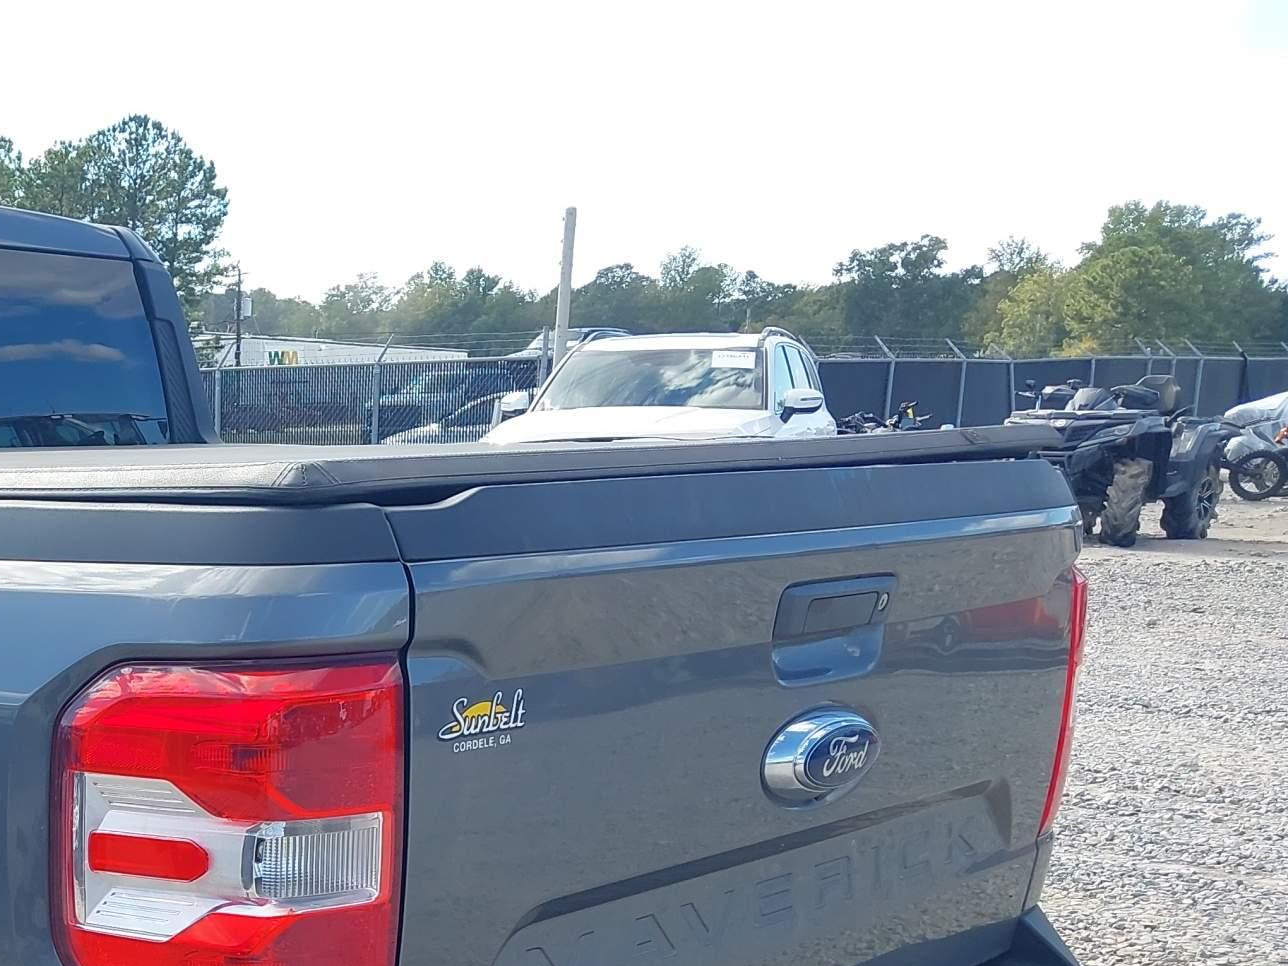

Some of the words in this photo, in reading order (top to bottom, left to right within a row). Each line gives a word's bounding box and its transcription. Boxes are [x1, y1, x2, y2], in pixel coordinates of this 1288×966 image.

[268, 350, 298, 365] WM
[438, 688, 526, 739] Sunbelt
[453, 736, 497, 753] CORDELE,
[499, 734, 512, 745] GA
[823, 734, 869, 778] Ford
